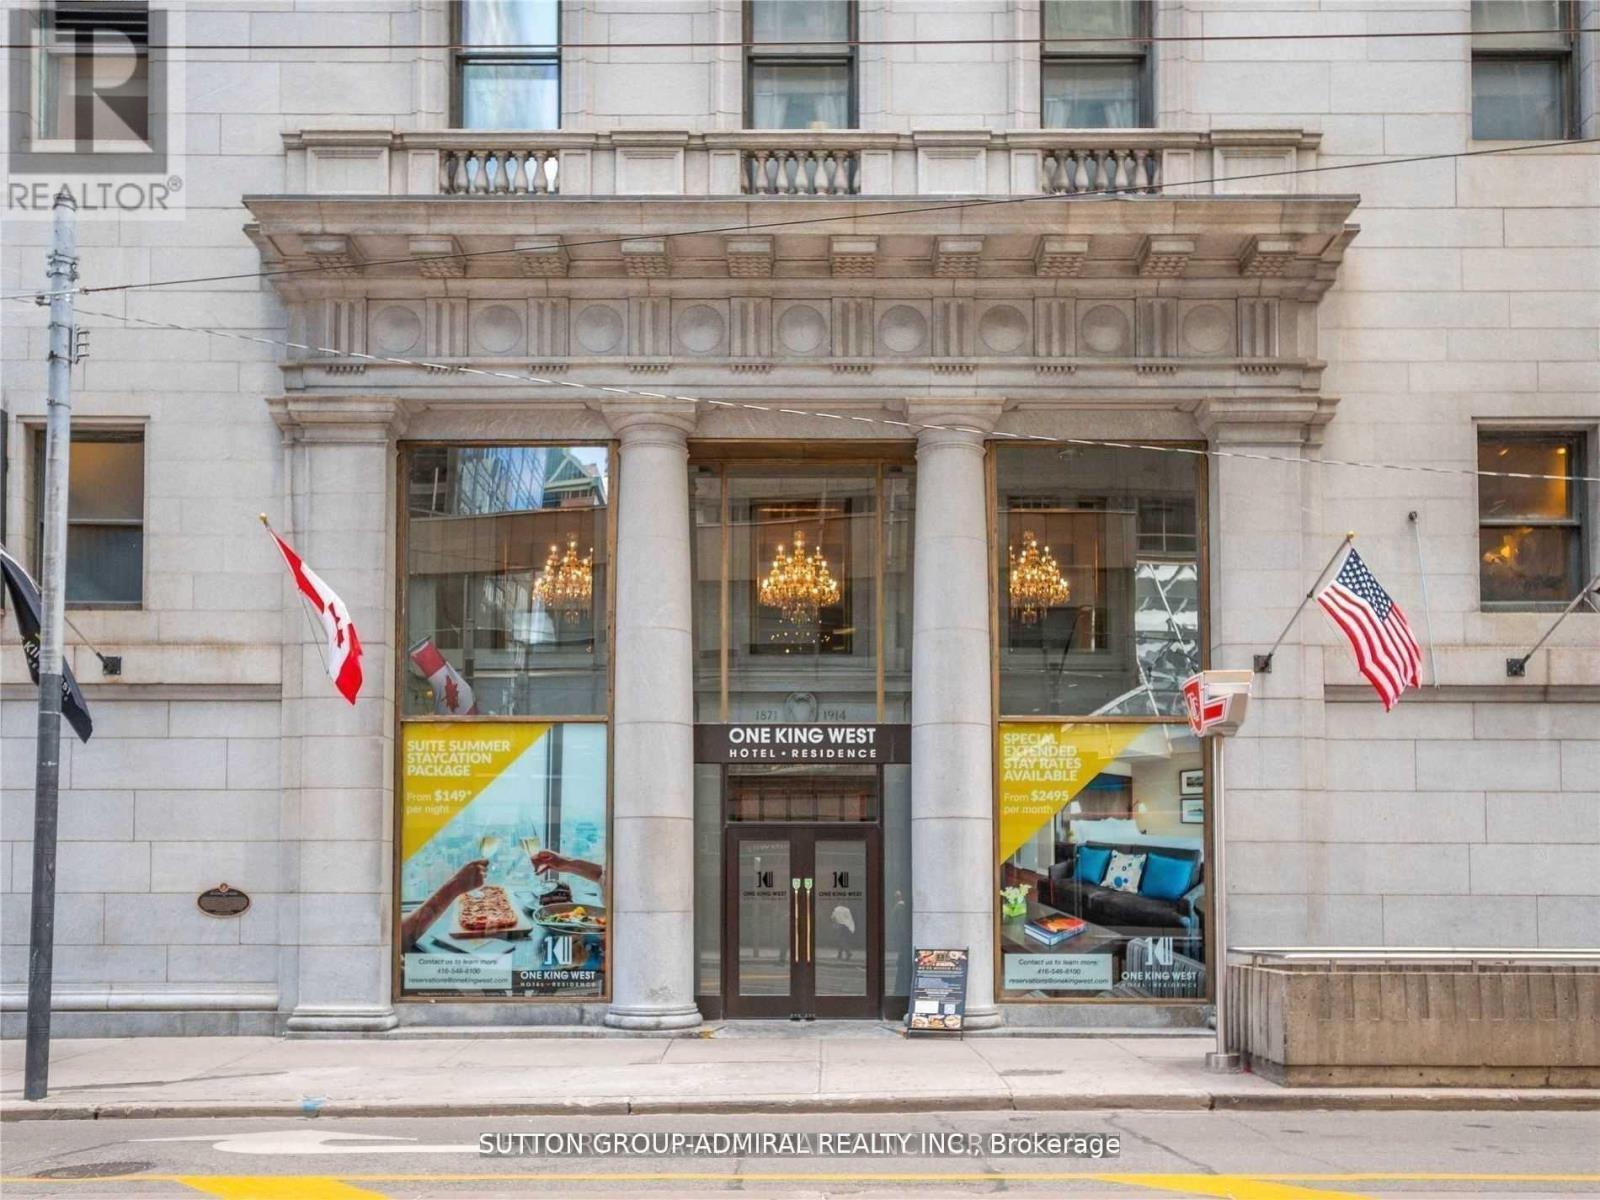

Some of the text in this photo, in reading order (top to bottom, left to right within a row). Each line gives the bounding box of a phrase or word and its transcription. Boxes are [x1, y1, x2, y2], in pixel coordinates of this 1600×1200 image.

[823, 709, 846, 721] 1914
[728, 728, 877, 744] ONE KING WEST
[1003, 733, 1058, 745] SPECIAL
[407, 740, 511, 752] SUITE SUMMER
[407, 752, 492, 764] STAYCATION
[729, 749, 877, 758] HOTEL RESIDENCE
[1003, 757, 1082, 769] STAY RATES
[407, 765, 471, 776] PACKAGE
[1003, 769, 1078, 781] AVAILABLE
[406, 791, 432, 801] From
[1003, 789, 1070, 802] From $2495
[406, 806, 422, 816] per
[1004, 806, 1020, 816] per
[520, 971, 596, 980] ONE KING WEST
[1121, 971, 1197, 980] ONE KING WEST
